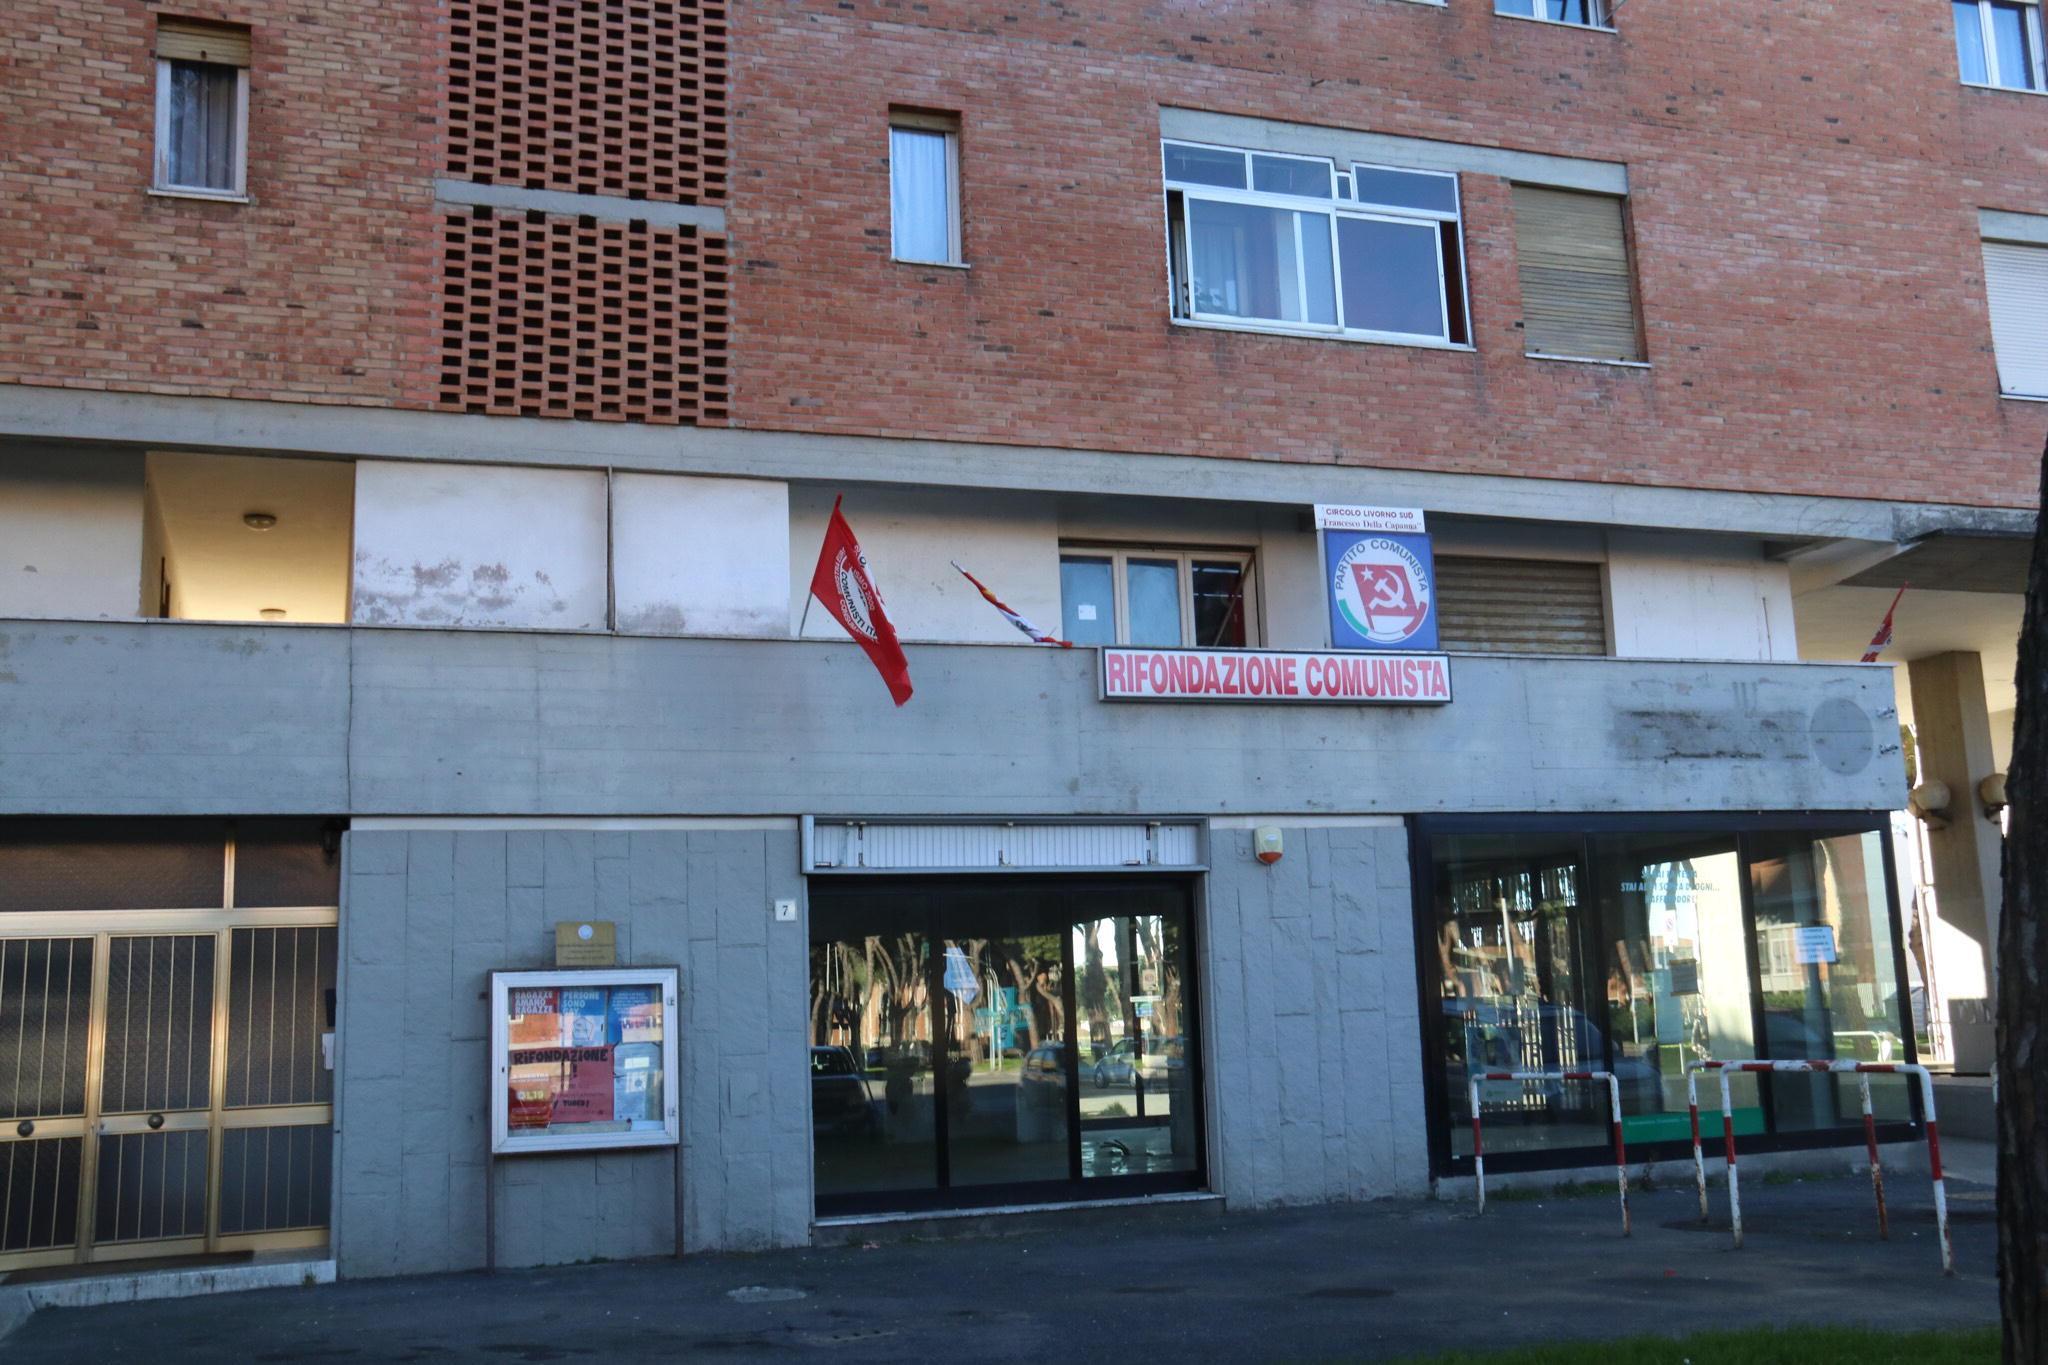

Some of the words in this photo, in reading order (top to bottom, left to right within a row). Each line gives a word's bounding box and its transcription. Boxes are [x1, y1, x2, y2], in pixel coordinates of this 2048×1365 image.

[1326, 508, 1361, 516] CIRCOLO
[1364, 510, 1397, 518] LIVORNO
[1363, 520, 1382, 528] Della
[1335, 543, 1366, 590] PARTITO
[1370, 540, 1428, 592] COMUNISTA
[841, 571, 866, 628] COMUNISTI
[1107, 653, 1298, 696] RIFONDAZIONE
[1305, 657, 1449, 698] COMUNISTA
[1620, 882, 1637, 892] STAI
[783, 905, 788, 916] 7
[563, 991, 600, 1000] PERSONE
[563, 999, 586, 1008] SONO
